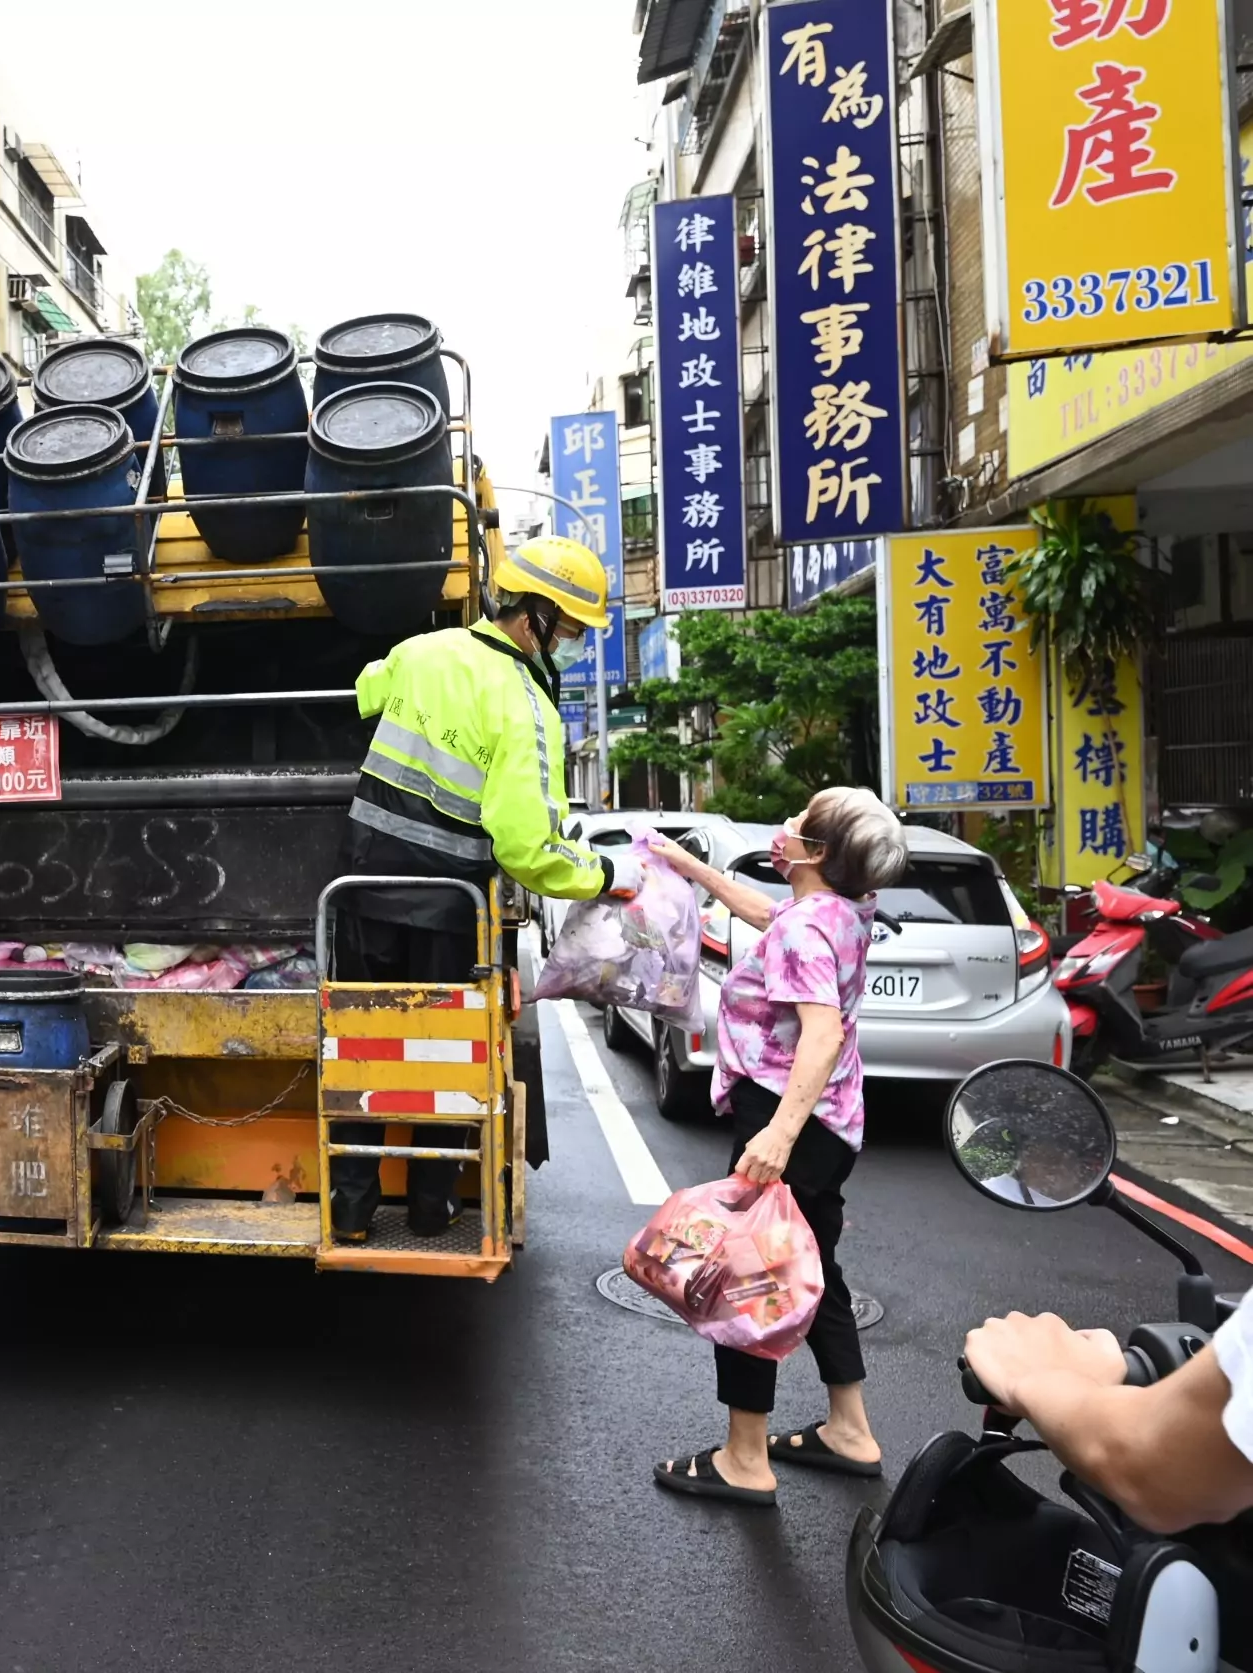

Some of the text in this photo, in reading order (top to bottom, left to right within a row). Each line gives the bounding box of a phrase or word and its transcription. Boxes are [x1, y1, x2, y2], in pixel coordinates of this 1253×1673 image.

[780, 22, 887, 524] 有為法律事務所
[1022, 260, 1219, 323] 3337321
[674, 213, 725, 575] 律維地政士事務所
[668, 587, 745, 606] (03)3370320
[913, 549, 961, 773] 大有地政士
[1158, 1035, 1203, 1049] YAMAHA
[7, 1103, 47, 1197] 堆肥
